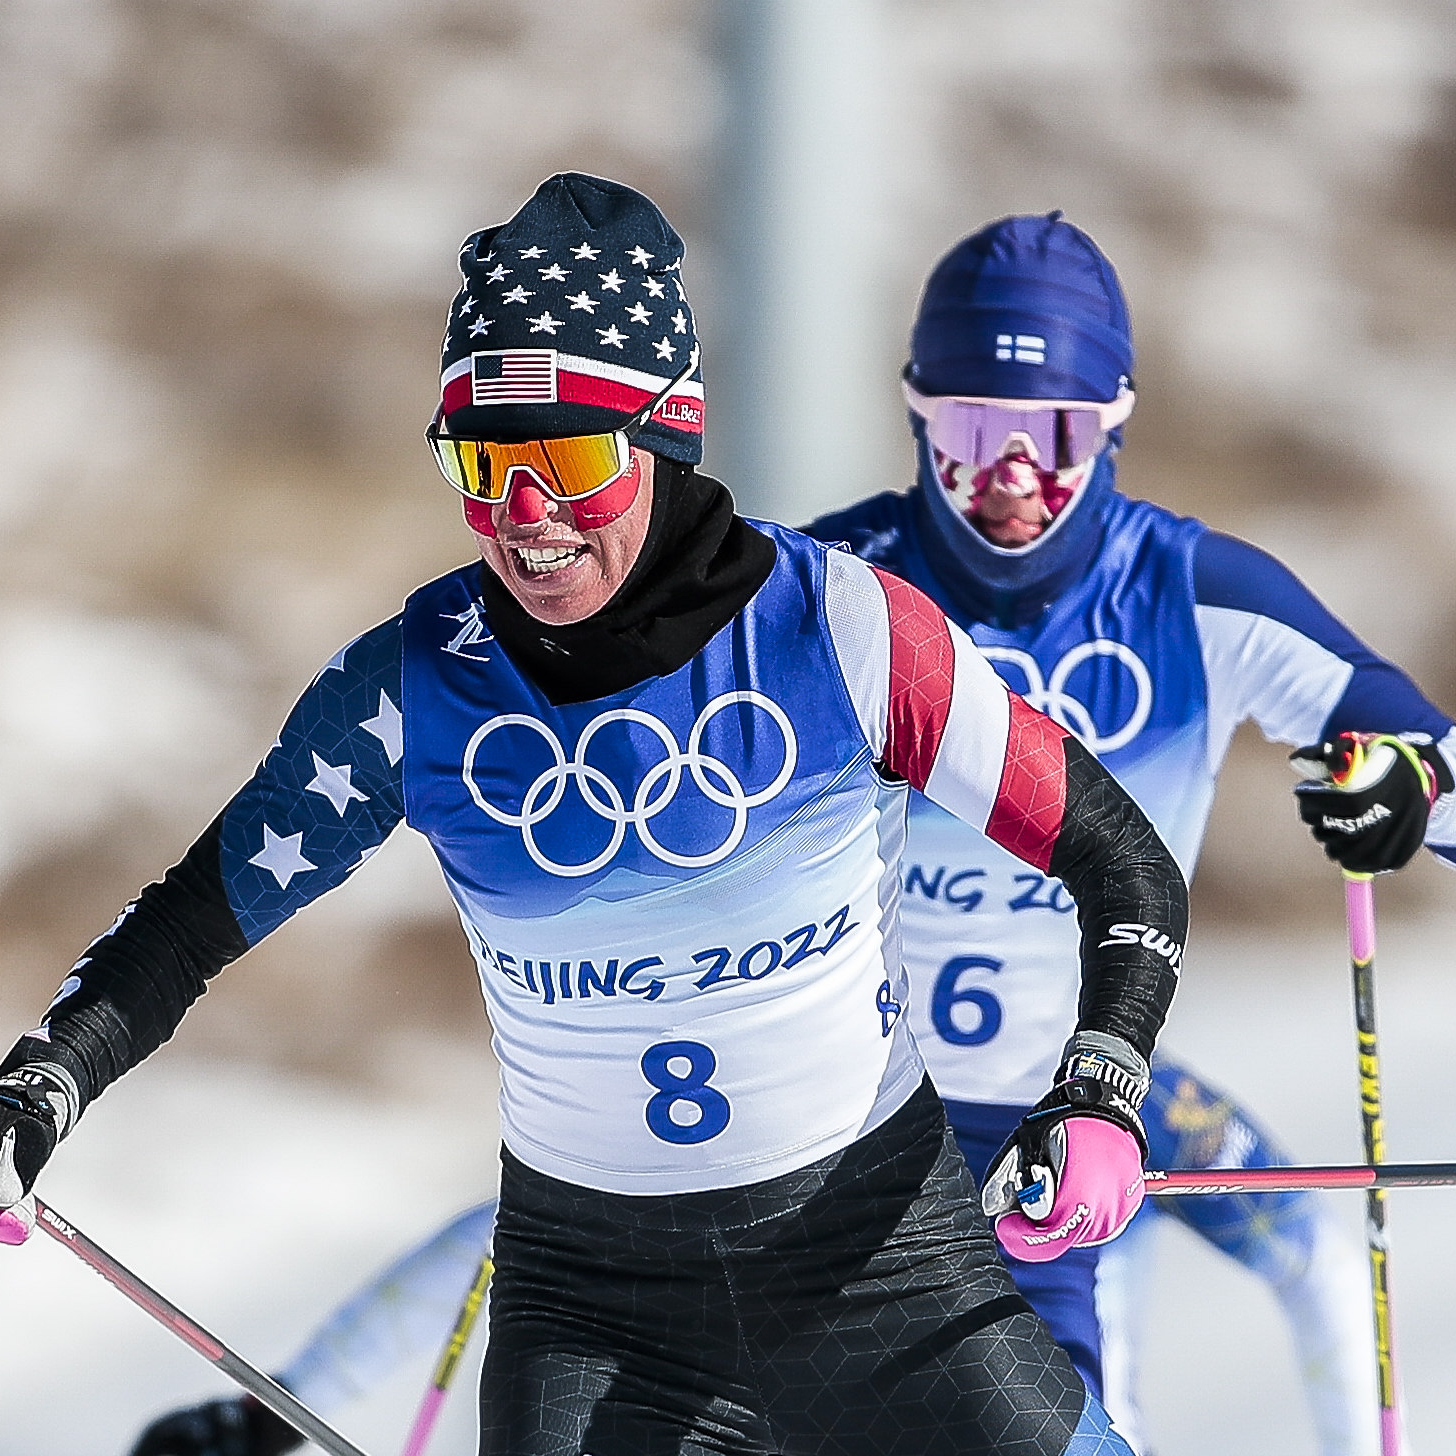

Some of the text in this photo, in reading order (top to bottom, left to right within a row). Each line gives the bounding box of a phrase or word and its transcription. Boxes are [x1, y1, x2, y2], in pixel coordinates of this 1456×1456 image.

[691, 903, 860, 991] 2022
[930, 955, 1004, 1047] 6
[641, 1040, 730, 1145] 8
[42, 1208, 77, 1240] SWIX
